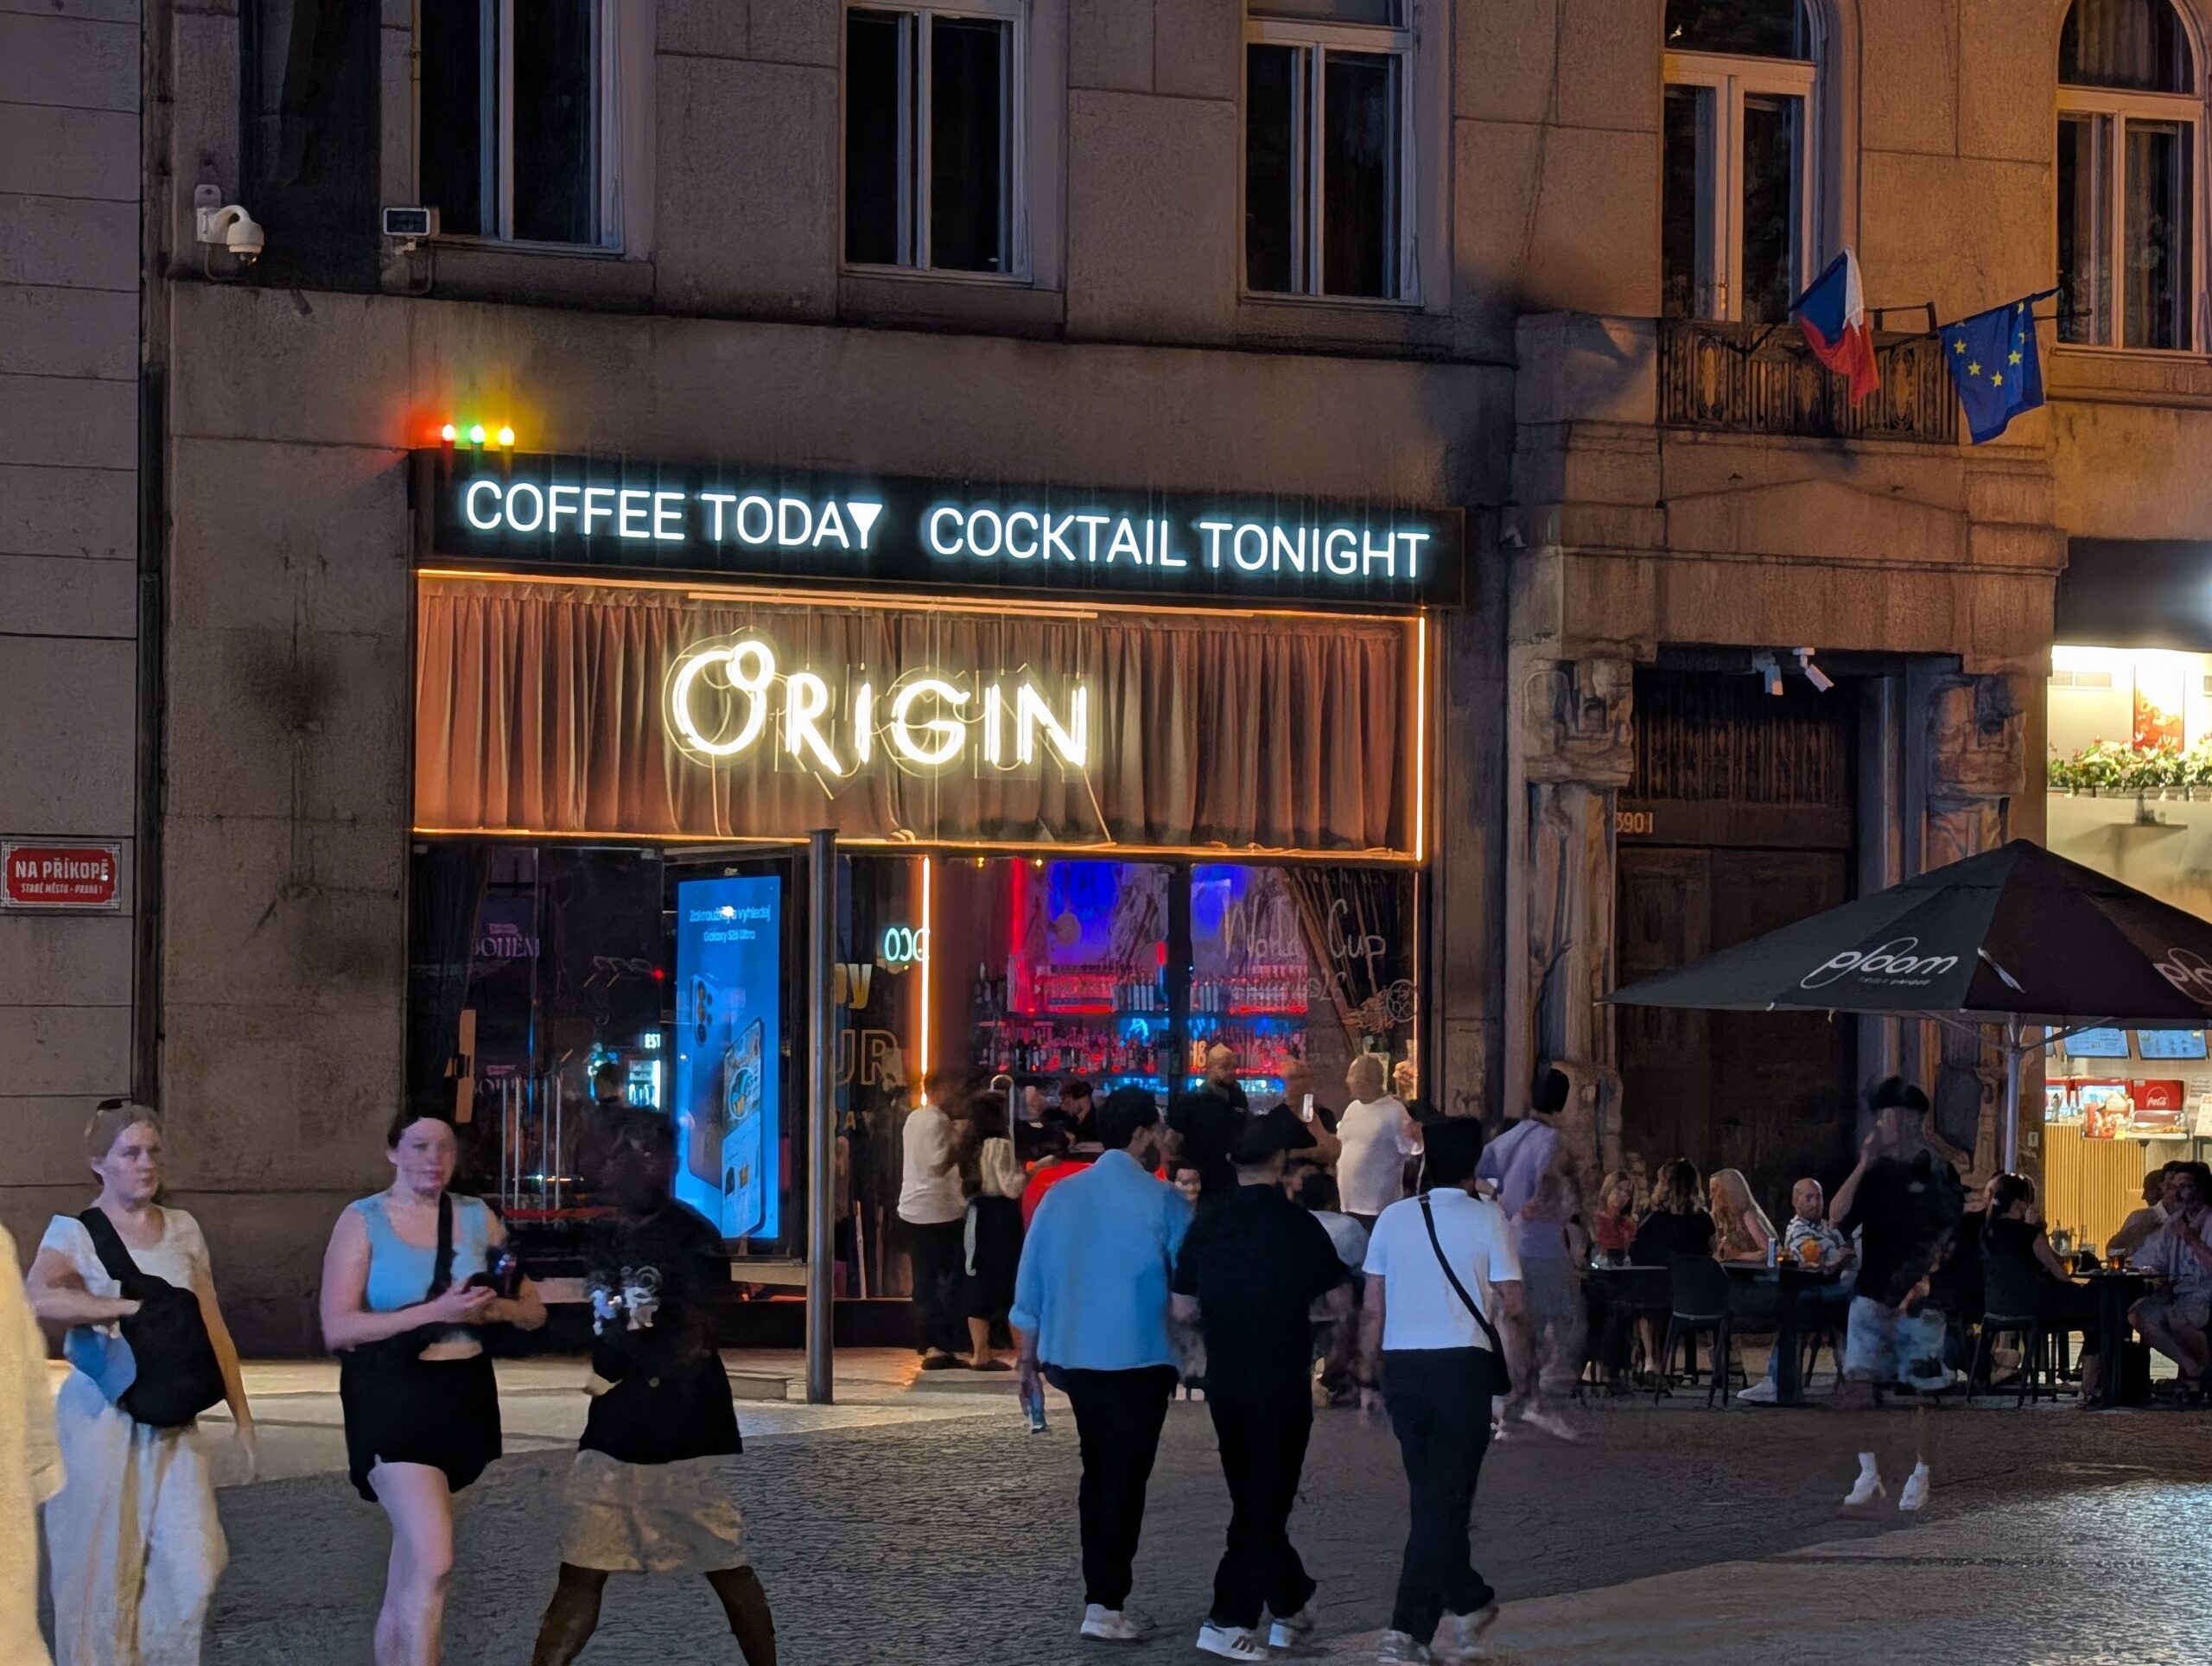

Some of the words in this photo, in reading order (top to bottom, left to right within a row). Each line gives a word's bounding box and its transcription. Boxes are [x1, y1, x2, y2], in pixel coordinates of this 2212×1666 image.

[465, 480, 686, 541] COFFEE
[701, 493, 884, 550] TODAY
[929, 506, 1188, 568] COCKTAIL
[1198, 521, 1431, 579] TONIGHT
[671, 639, 1089, 776] ORIGIN
[15, 860, 38, 878] NA
[42, 857, 109, 881] PŘÍKOPĚ
[21, 882, 44, 893] STARÉ
[45, 882, 69, 893] MĚSTO
[74, 884, 99, 894] PRAHA
[703, 931, 727, 944] Galaxy
[1327, 898, 1387, 982] Cup
[1800, 937, 1959, 989] ploom
